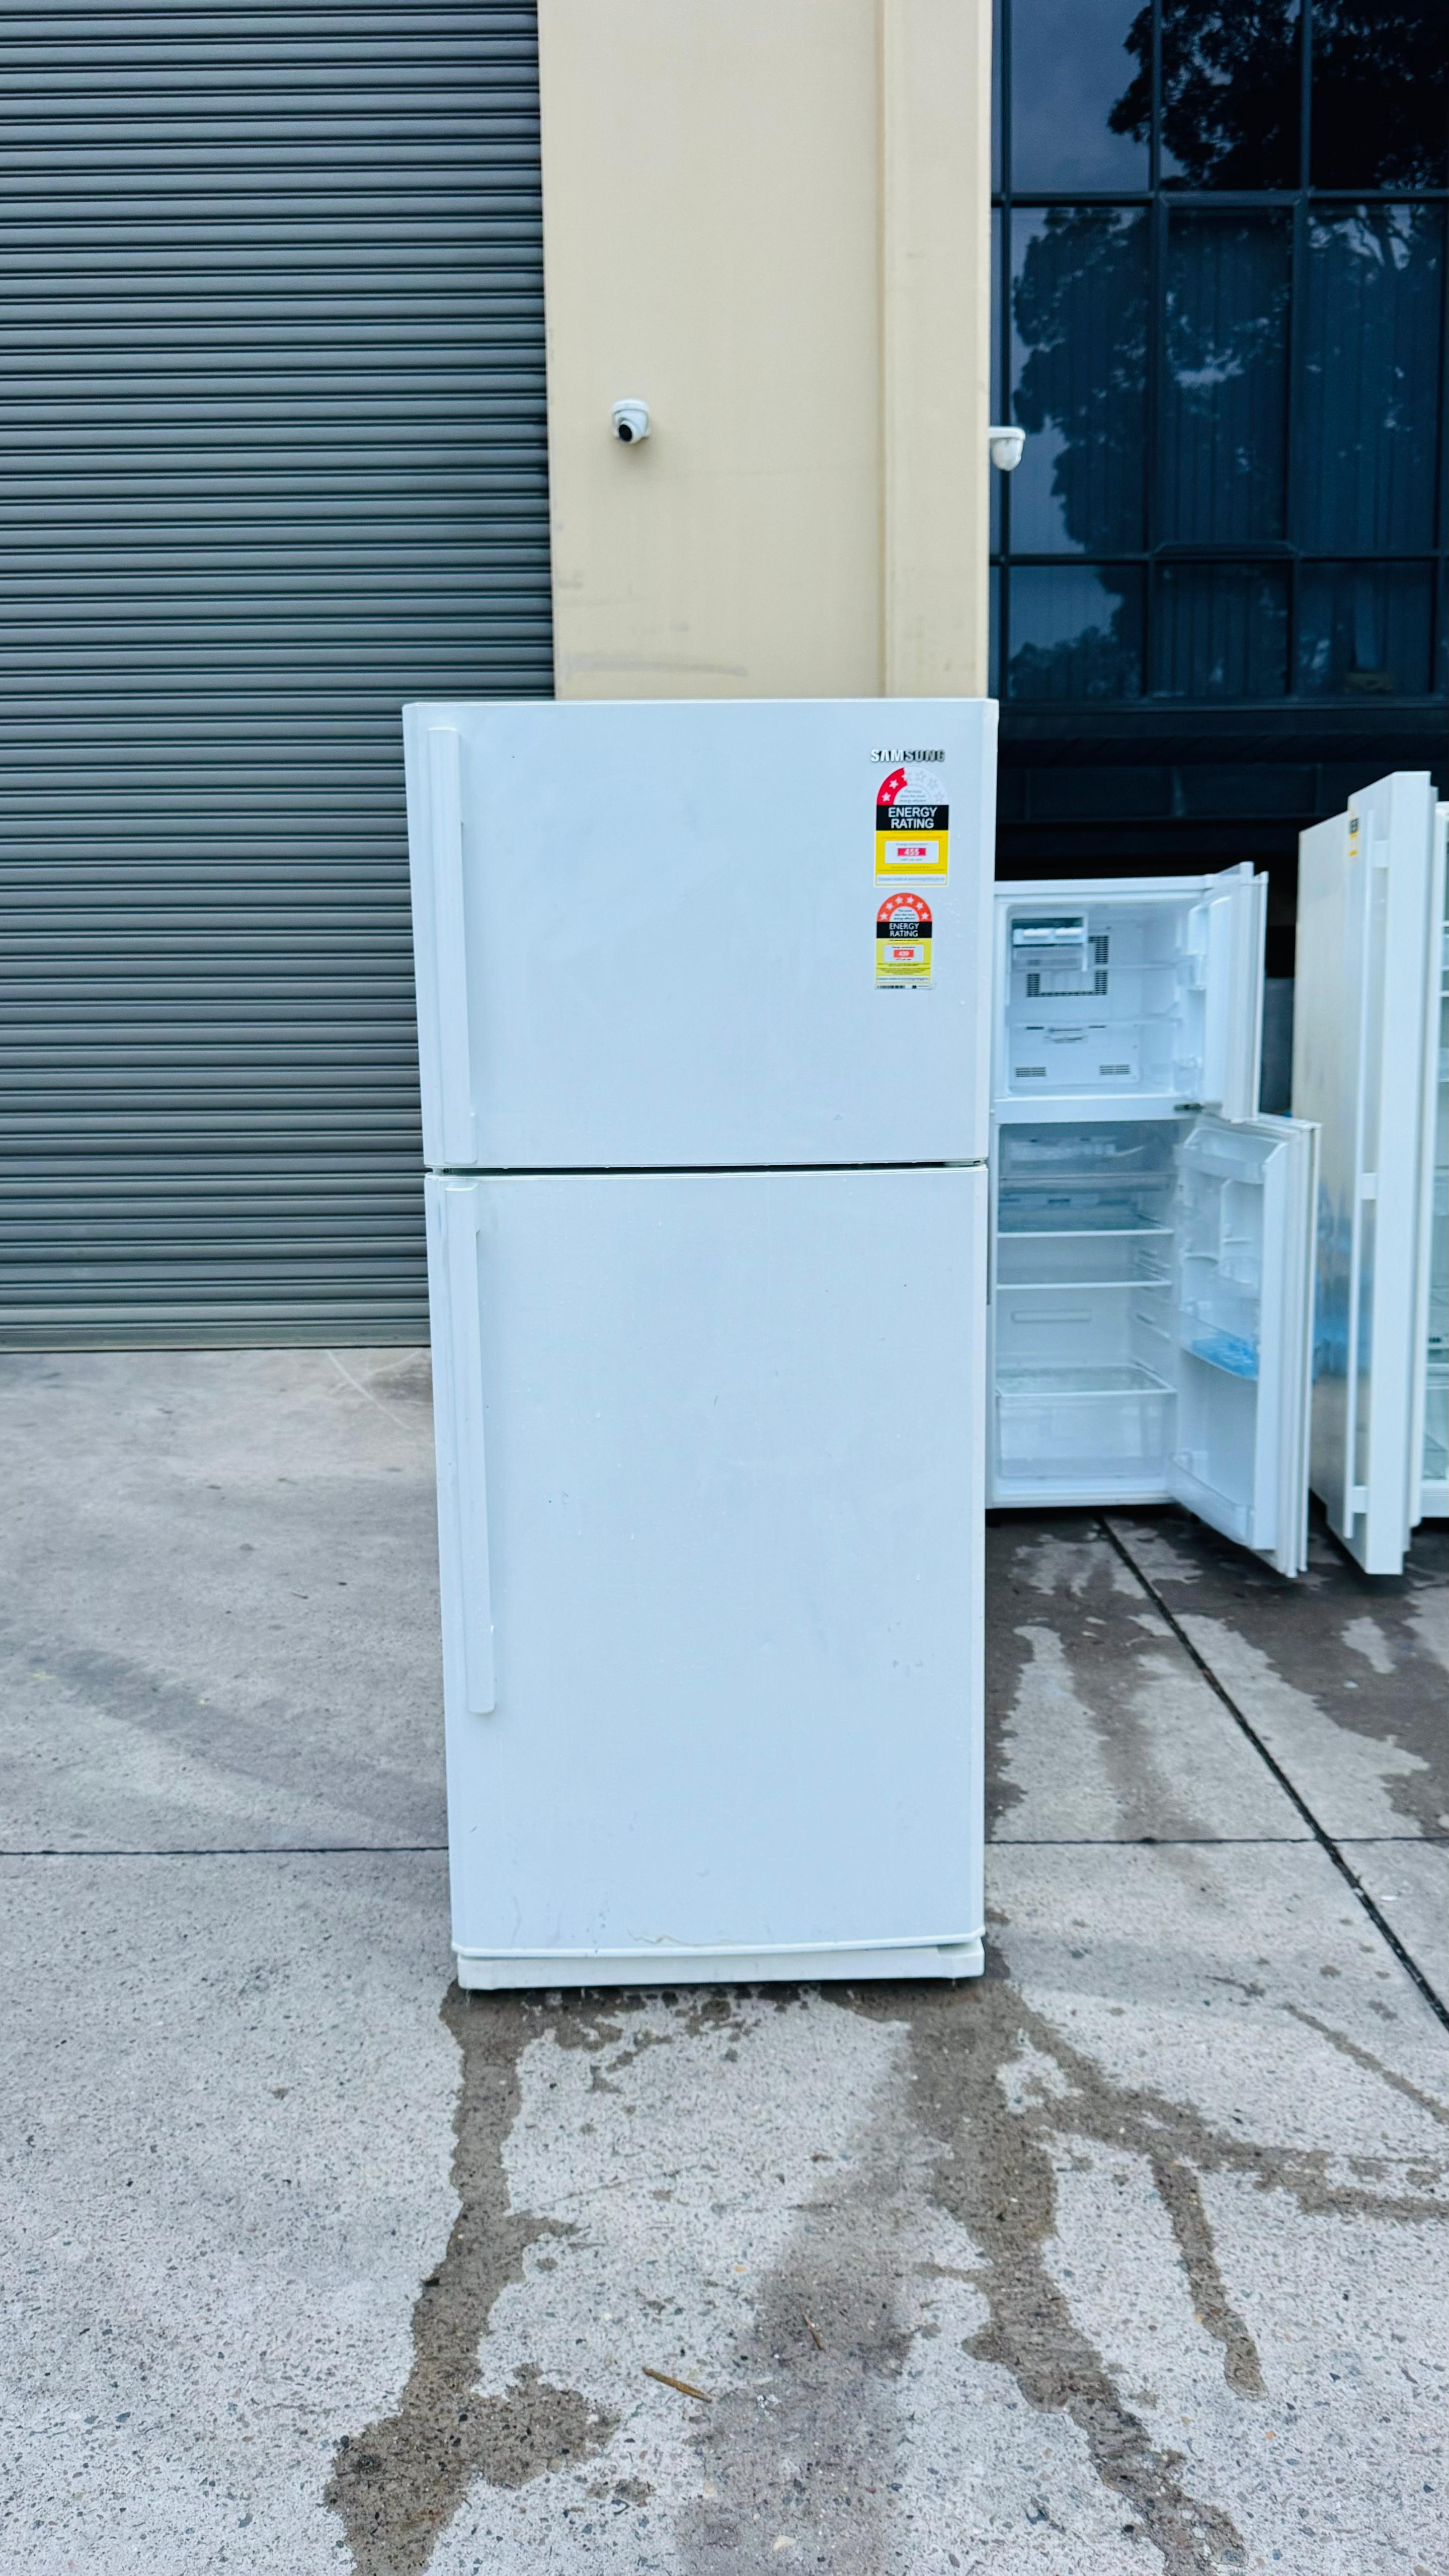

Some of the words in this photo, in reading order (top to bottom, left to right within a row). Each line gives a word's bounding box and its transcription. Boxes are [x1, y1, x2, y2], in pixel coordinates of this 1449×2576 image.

[870, 749, 945, 763] SAMSUNG
[888, 807, 937, 818] ENERGY
[891, 819, 934, 829] RATING
